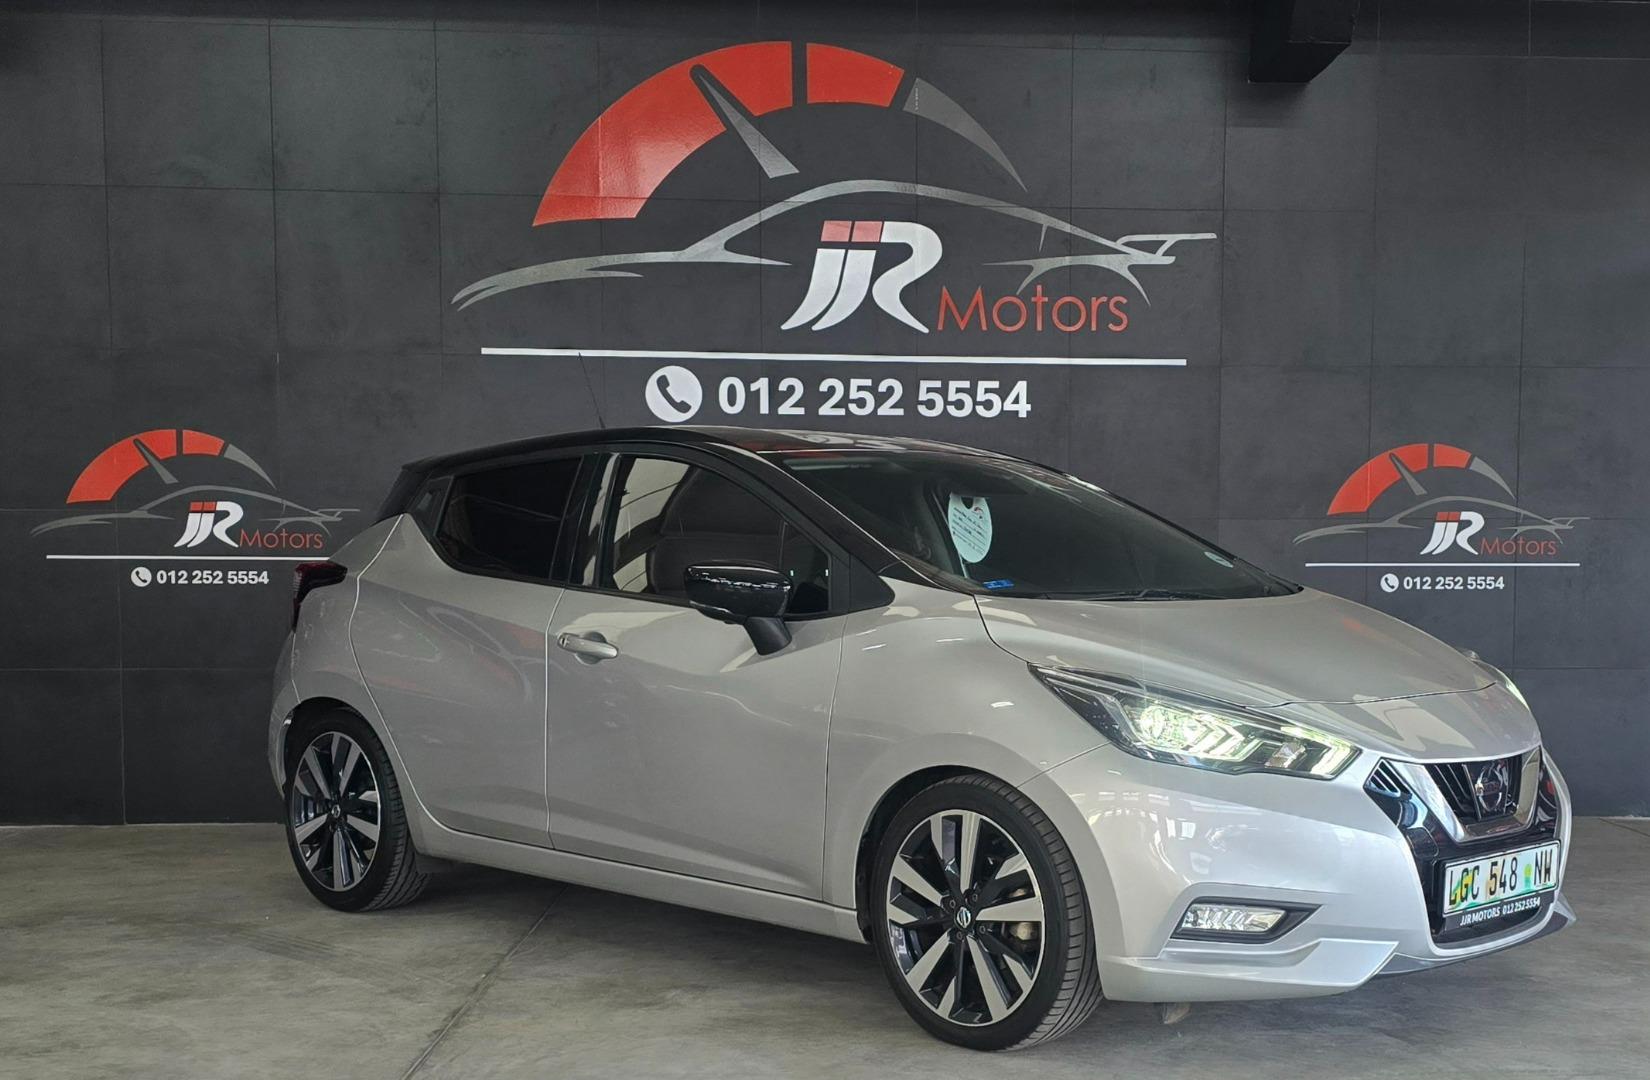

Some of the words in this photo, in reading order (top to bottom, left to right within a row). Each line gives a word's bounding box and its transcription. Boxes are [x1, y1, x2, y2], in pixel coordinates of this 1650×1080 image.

[938, 284, 1129, 333] Motors
[718, 377, 805, 415] 012
[818, 379, 904, 416] 252
[916, 380, 1031, 418] 5554
[240, 528, 323, 549] Motors
[1480, 537, 1557, 556] Motors
[156, 570, 188, 584] 012
[192, 570, 224, 584] 252
[227, 570, 269, 585] 5554
[1403, 576, 1432, 590] 012
[1435, 576, 1464, 590] 252
[1467, 576, 1505, 590] 5554
[1449, 866, 1479, 905] LGC
[1489, 857, 1518, 896] 548
[1534, 848, 1553, 886] NW
[1472, 908, 1500, 923] MOTORS
[1502, 905, 1514, 915] 012
[1515, 902, 1525, 911] 252
[1525, 897, 1540, 908] 5554
